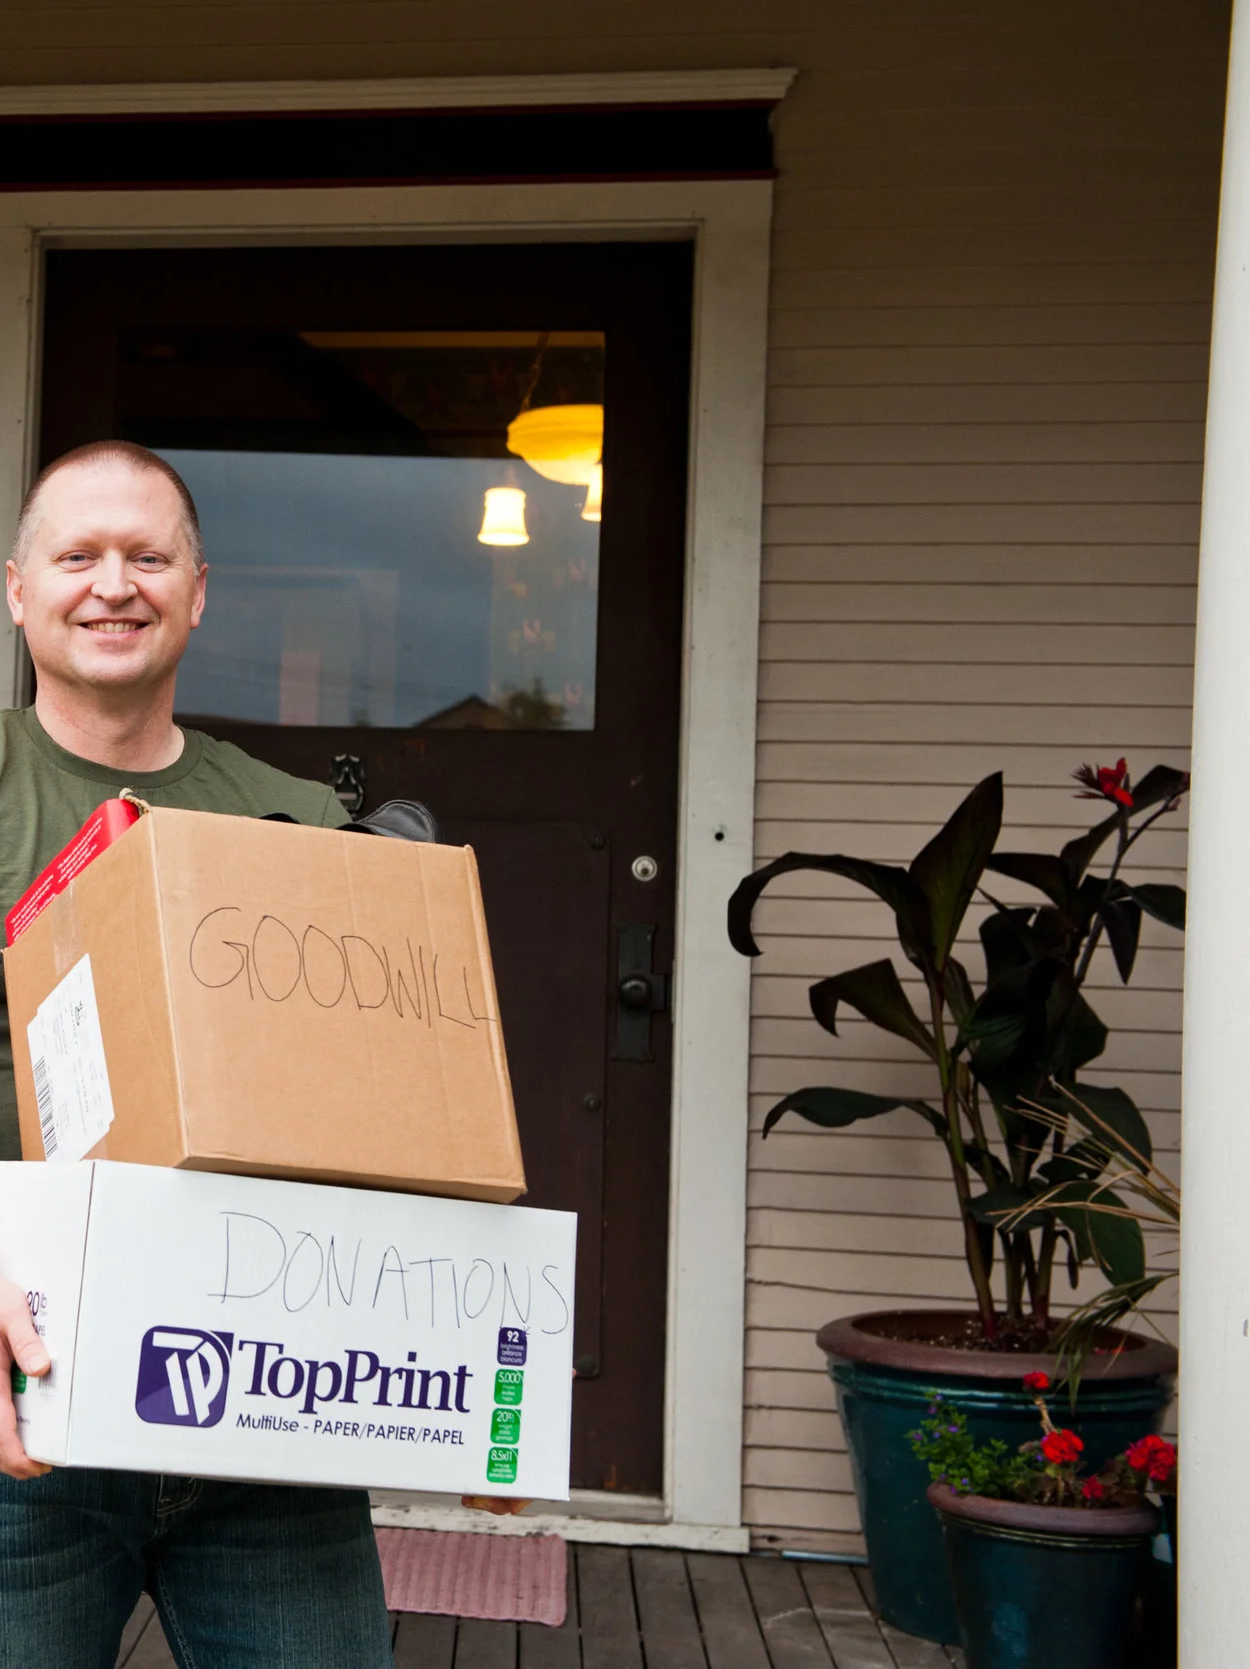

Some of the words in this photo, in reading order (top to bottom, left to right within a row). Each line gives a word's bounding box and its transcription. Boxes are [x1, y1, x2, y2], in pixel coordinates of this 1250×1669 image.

[190, 907, 497, 1029] GOODWILL
[207, 1211, 569, 1335] DONATIONS
[506, 1330, 520, 1343] 92
[238, 1339, 473, 1415] TopPrint
[236, 1413, 299, 1433] MultiUse
